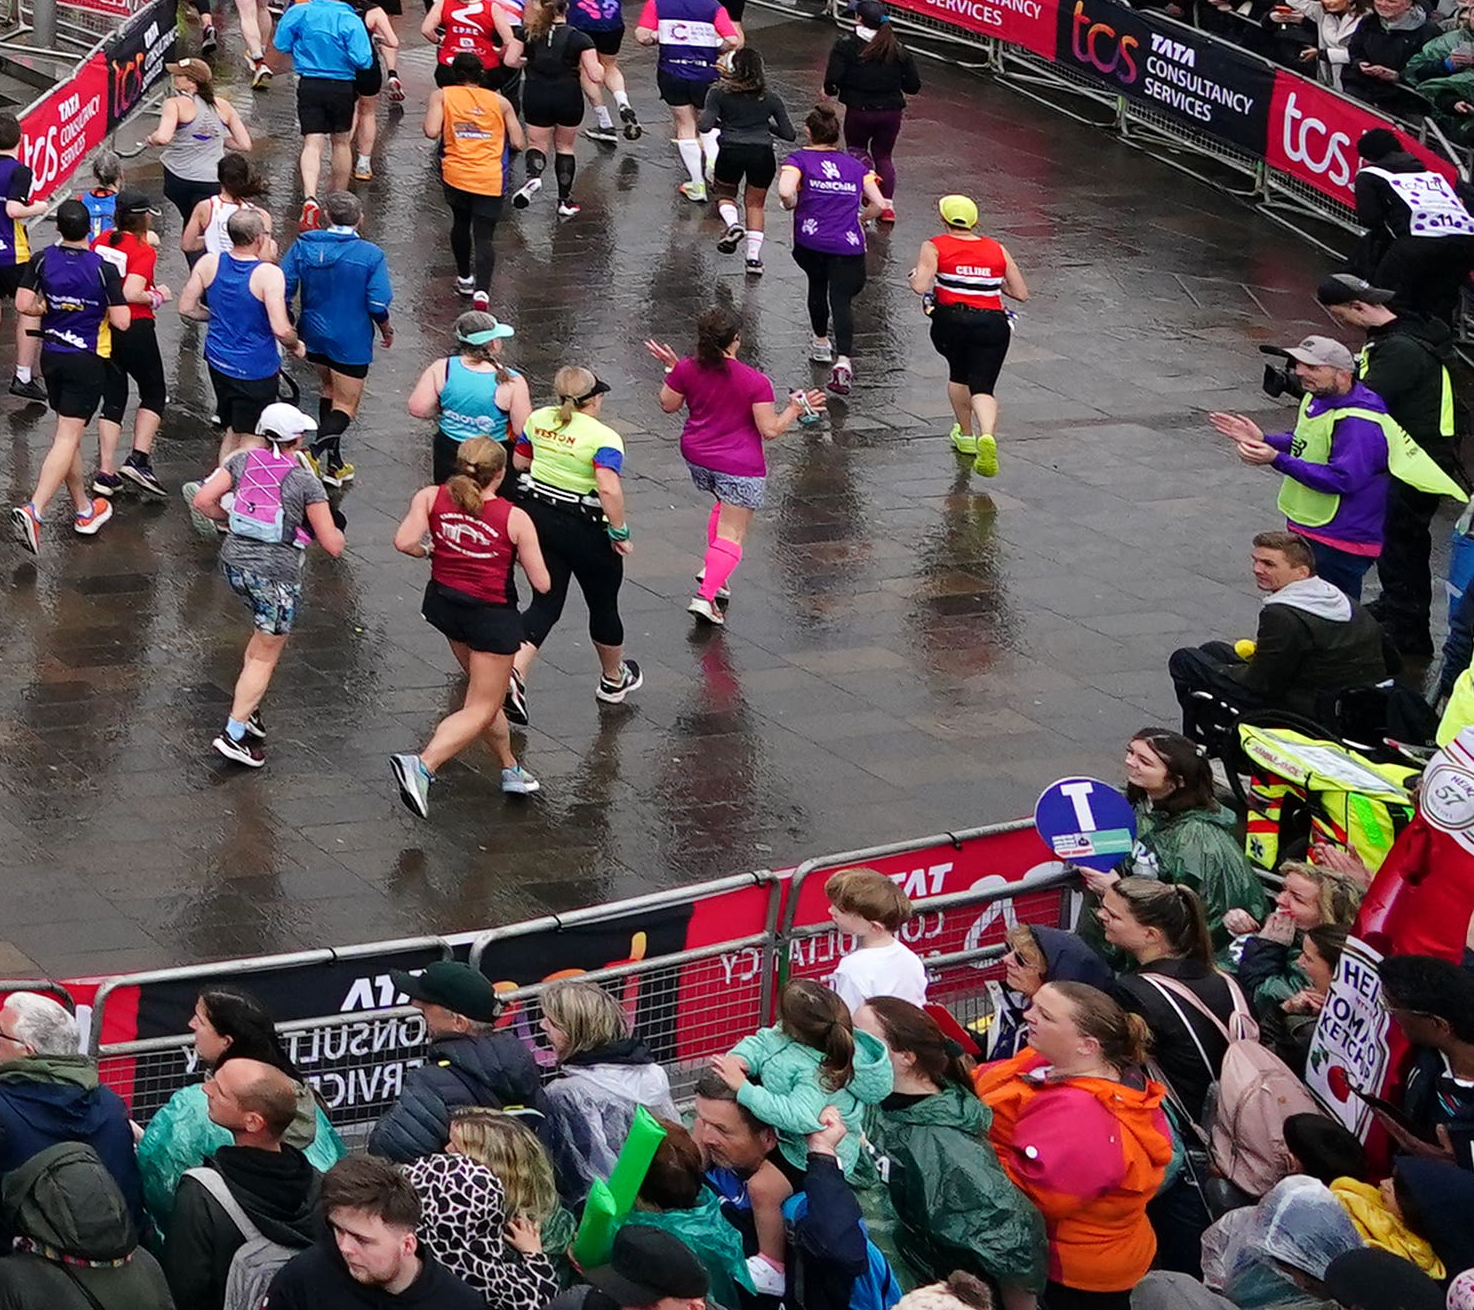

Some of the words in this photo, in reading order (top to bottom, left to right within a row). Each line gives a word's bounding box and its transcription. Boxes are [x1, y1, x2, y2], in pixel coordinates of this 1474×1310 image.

[1072, 0, 1139, 85] tcs
[1152, 33, 1194, 67] TATA
[1144, 57, 1253, 118] CONSULTANCY
[1144, 78, 1213, 125] SERVICES
[1283, 92, 1350, 185] tcs
